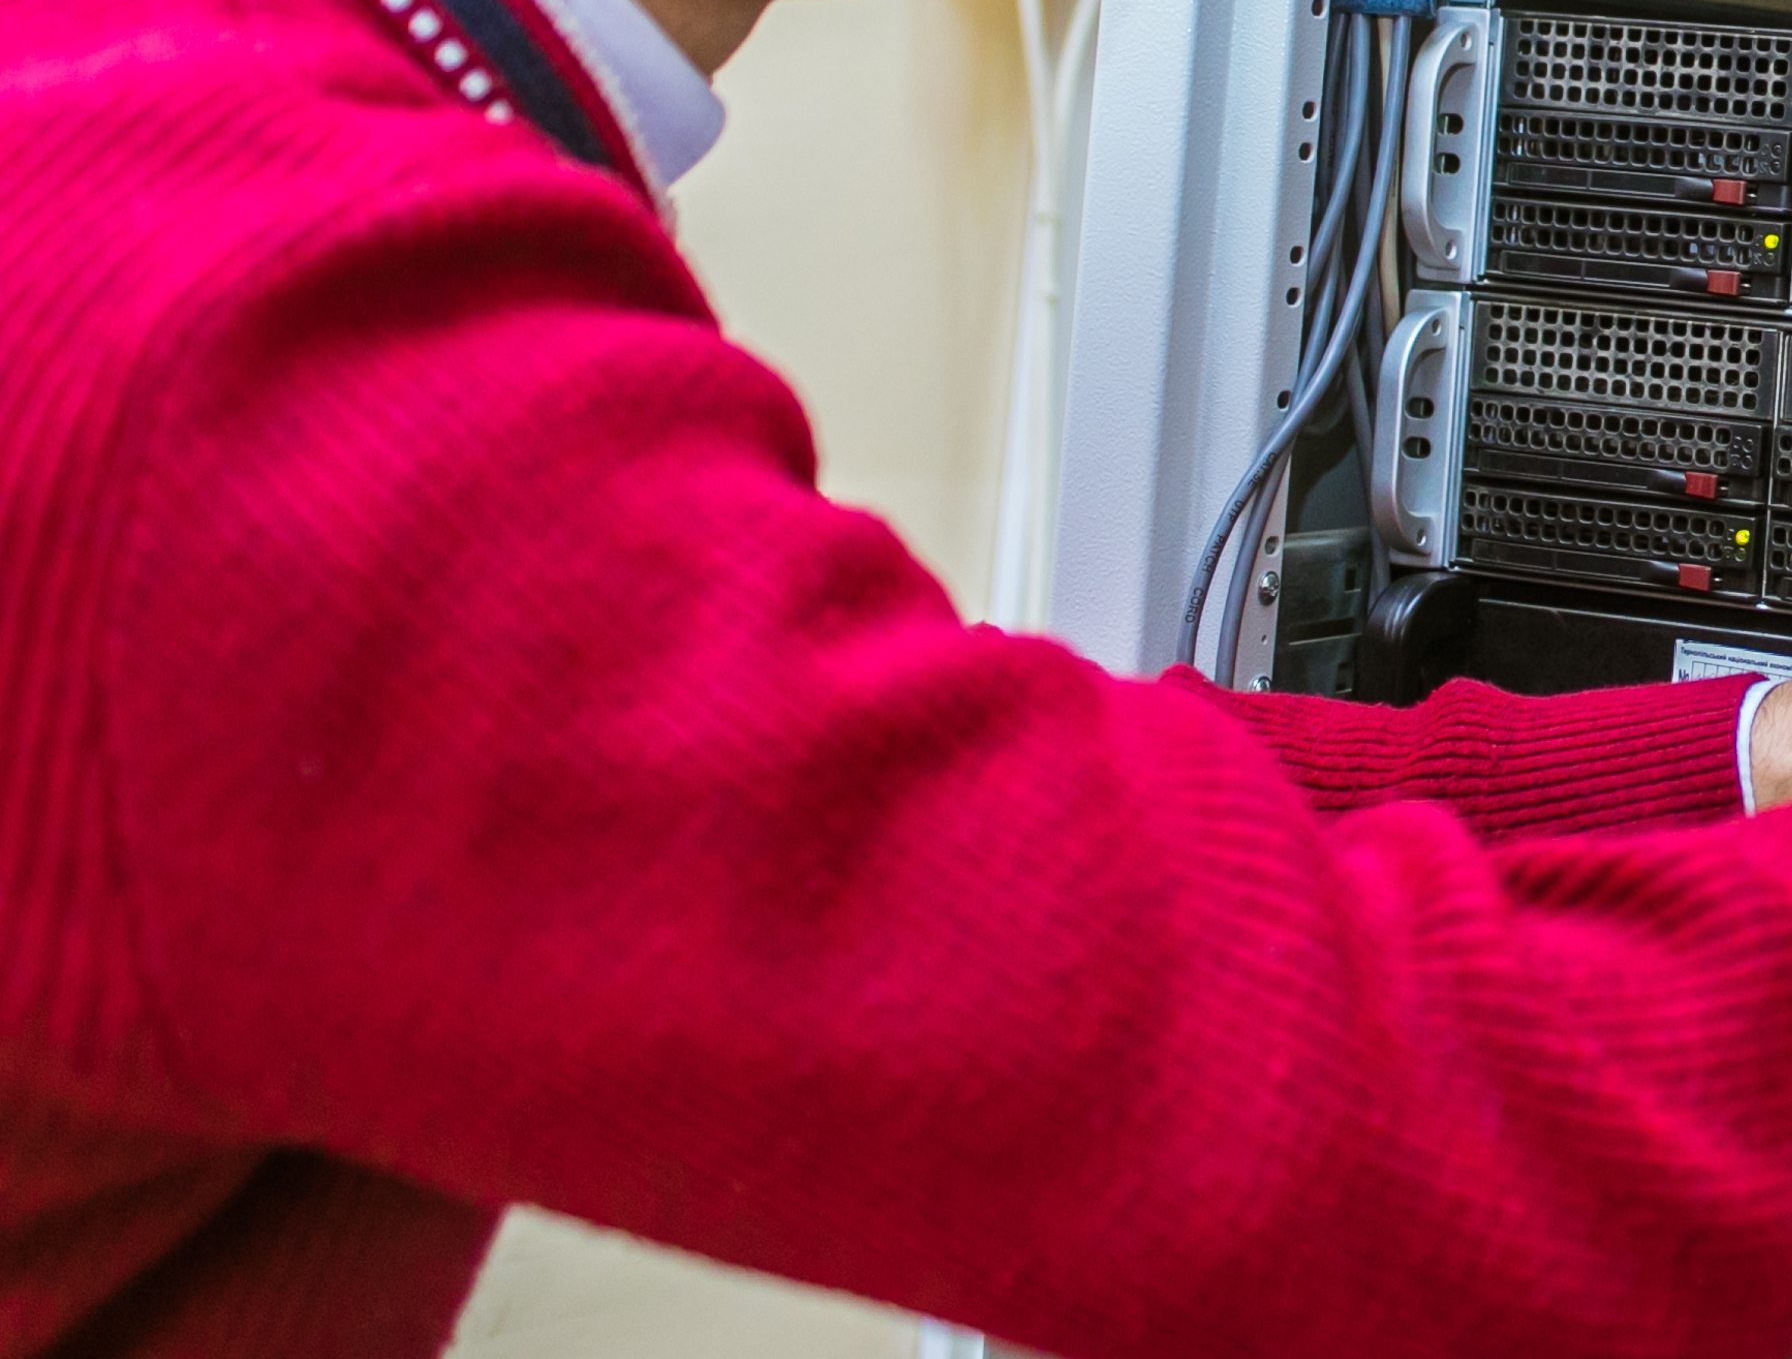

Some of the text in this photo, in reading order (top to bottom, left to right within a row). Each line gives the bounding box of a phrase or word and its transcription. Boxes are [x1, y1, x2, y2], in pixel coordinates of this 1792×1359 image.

[1228, 499, 1244, 523] UTP
[1202, 534, 1226, 573] PATCH
[1185, 587, 1204, 623] CORD
[1680, 646, 1727, 662] Тернопільський
[1728, 654, 1769, 668] національний
